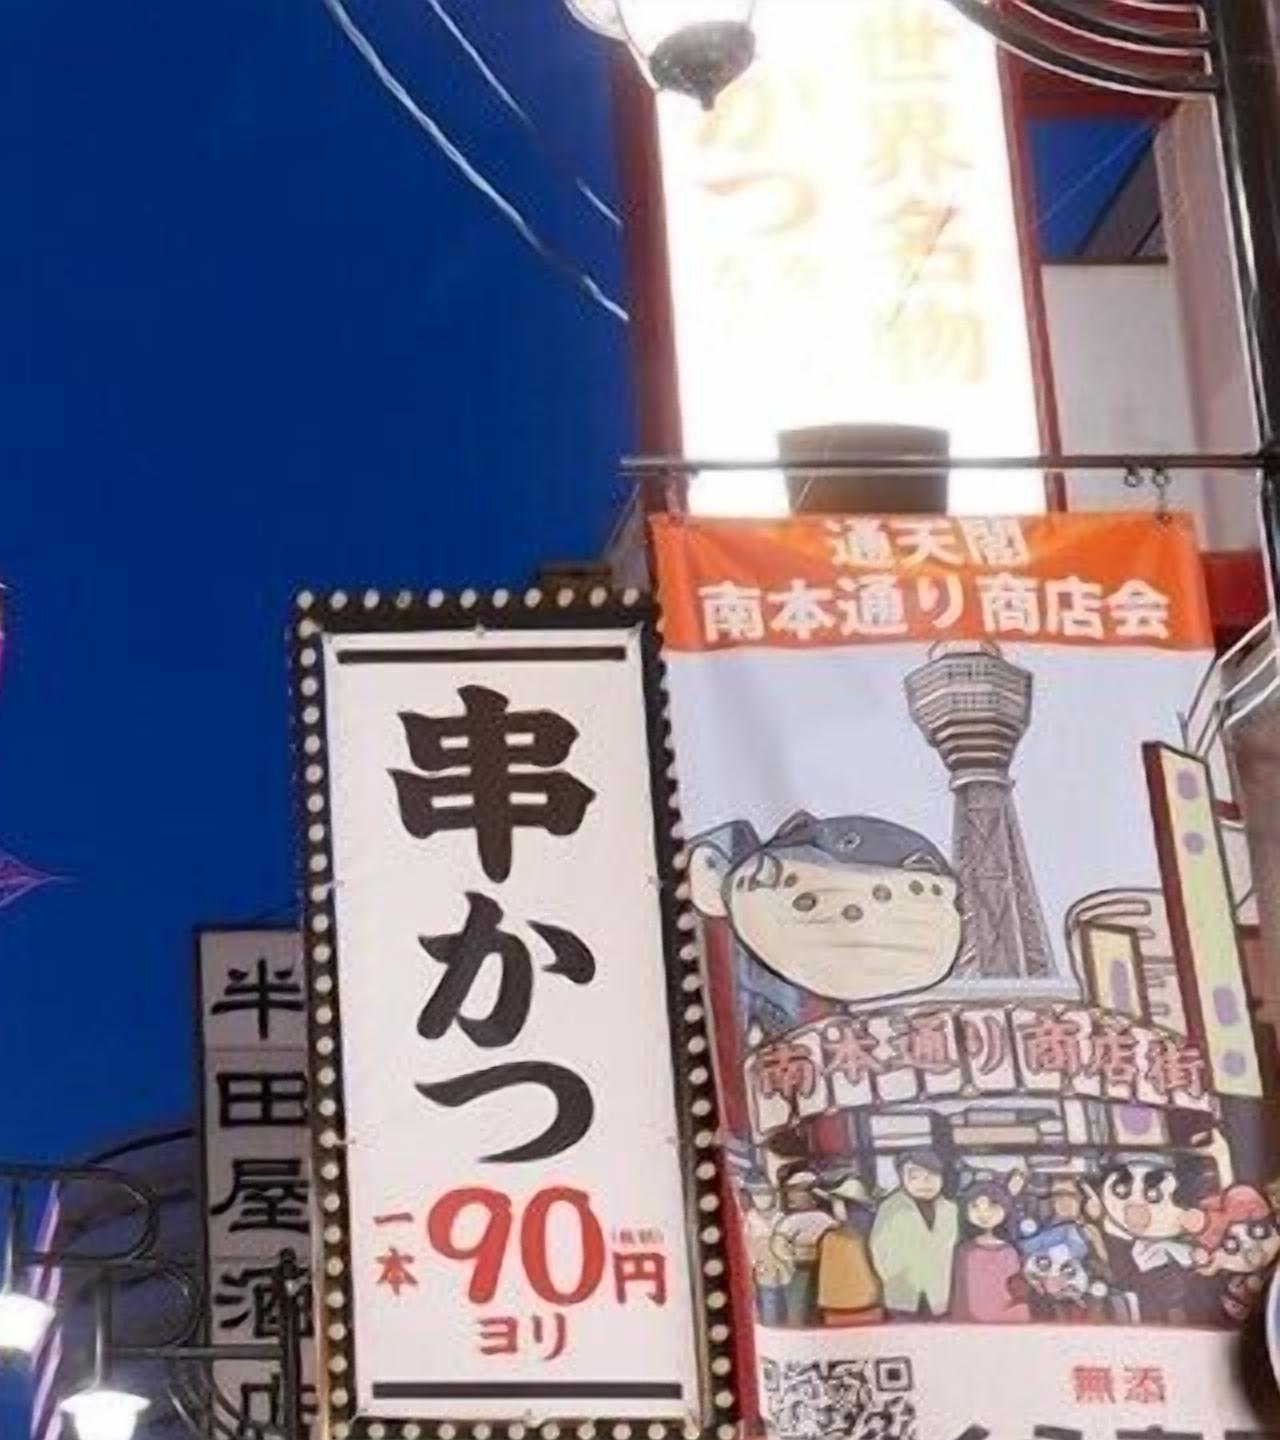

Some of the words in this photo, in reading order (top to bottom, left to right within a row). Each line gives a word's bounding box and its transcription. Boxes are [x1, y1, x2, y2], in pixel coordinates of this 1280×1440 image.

[697, 573, 1172, 644] 南本通り商店会
[386, 684, 598, 1165] 串かつ
[426, 1184, 607, 1307] 90
[612, 1251, 668, 1305] 円
[477, 1313, 568, 1361] ヨリ
